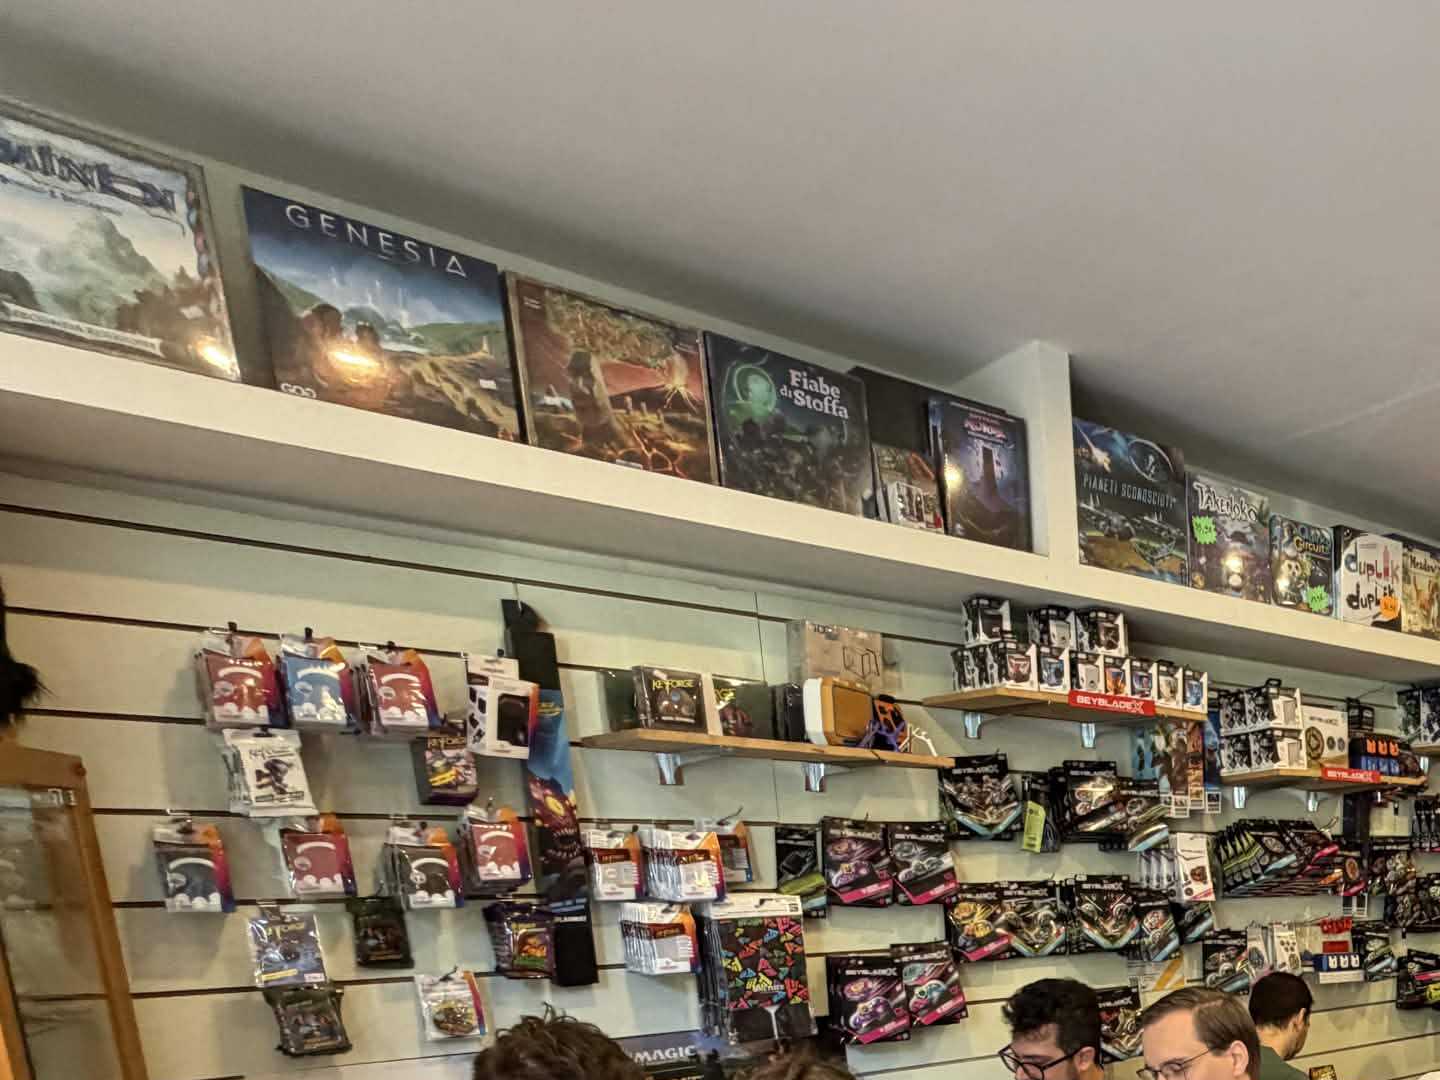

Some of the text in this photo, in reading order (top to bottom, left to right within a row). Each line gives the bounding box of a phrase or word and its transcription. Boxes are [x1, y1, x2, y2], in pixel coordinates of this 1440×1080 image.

[284, 204, 468, 278] GENESIA
[788, 368, 841, 399] Fiabe
[792, 389, 849, 420] Stoffa
[633, 1045, 698, 1064] MAGIC
